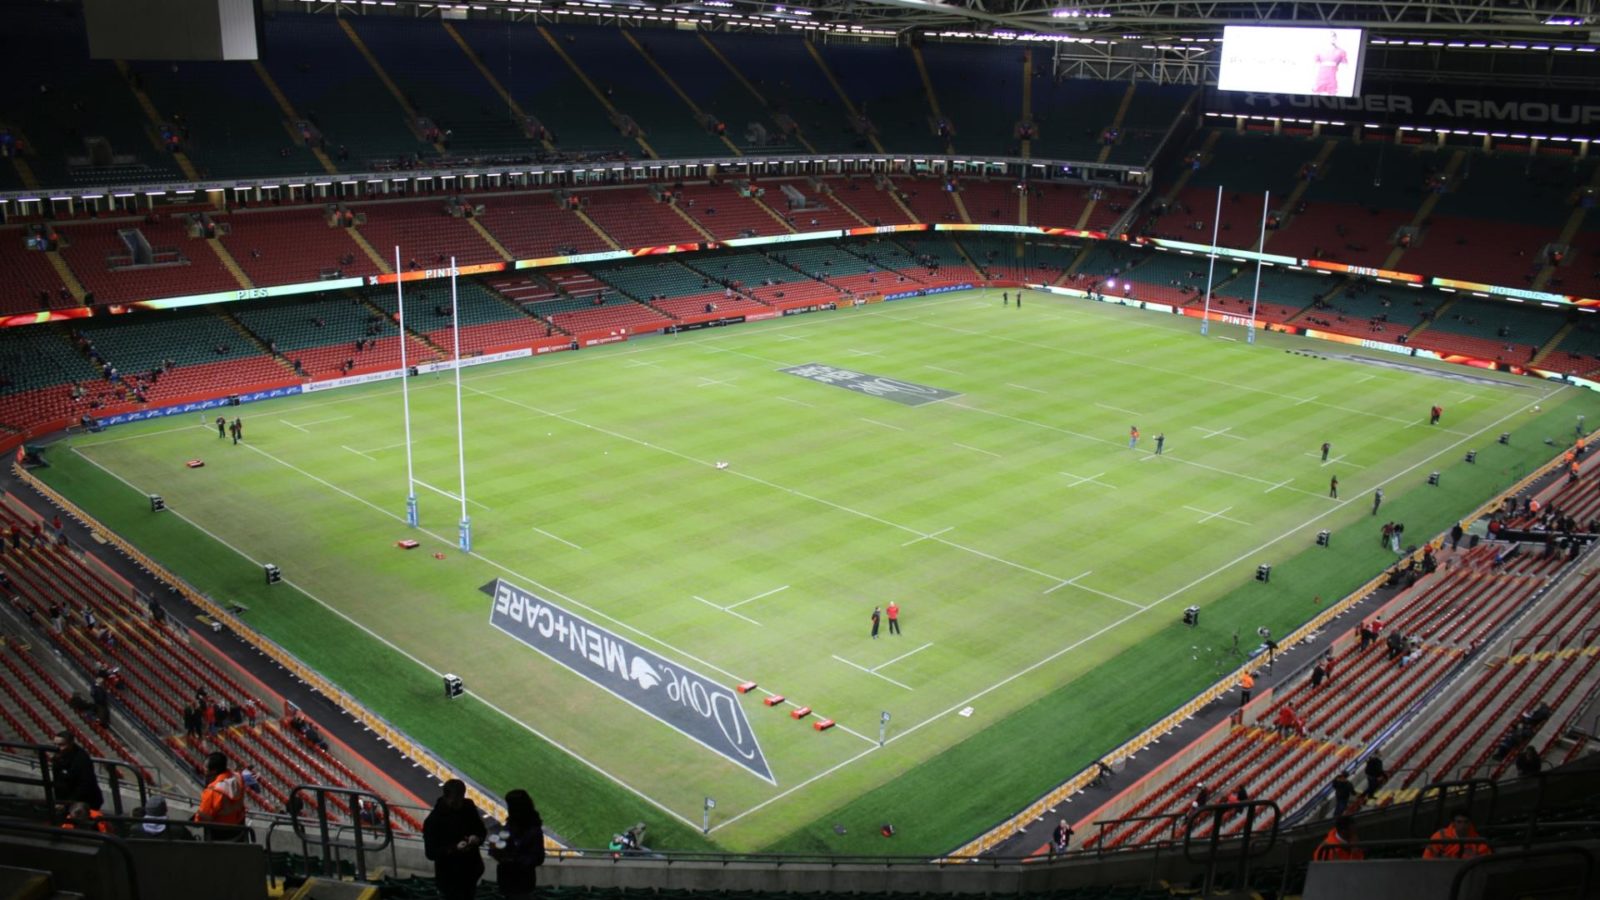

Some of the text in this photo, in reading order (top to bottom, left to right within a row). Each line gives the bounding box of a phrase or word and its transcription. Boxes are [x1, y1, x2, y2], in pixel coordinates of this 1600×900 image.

[1289, 94, 1413, 113] UNDER
[875, 225, 896, 234] PINTS
[425, 267, 460, 279] PINTS
[1347, 265, 1379, 277] PINTS
[237, 288, 268, 300] PIES
[1222, 314, 1254, 328] PINTS
[495, 585, 756, 760] Dove MEN+CARE
